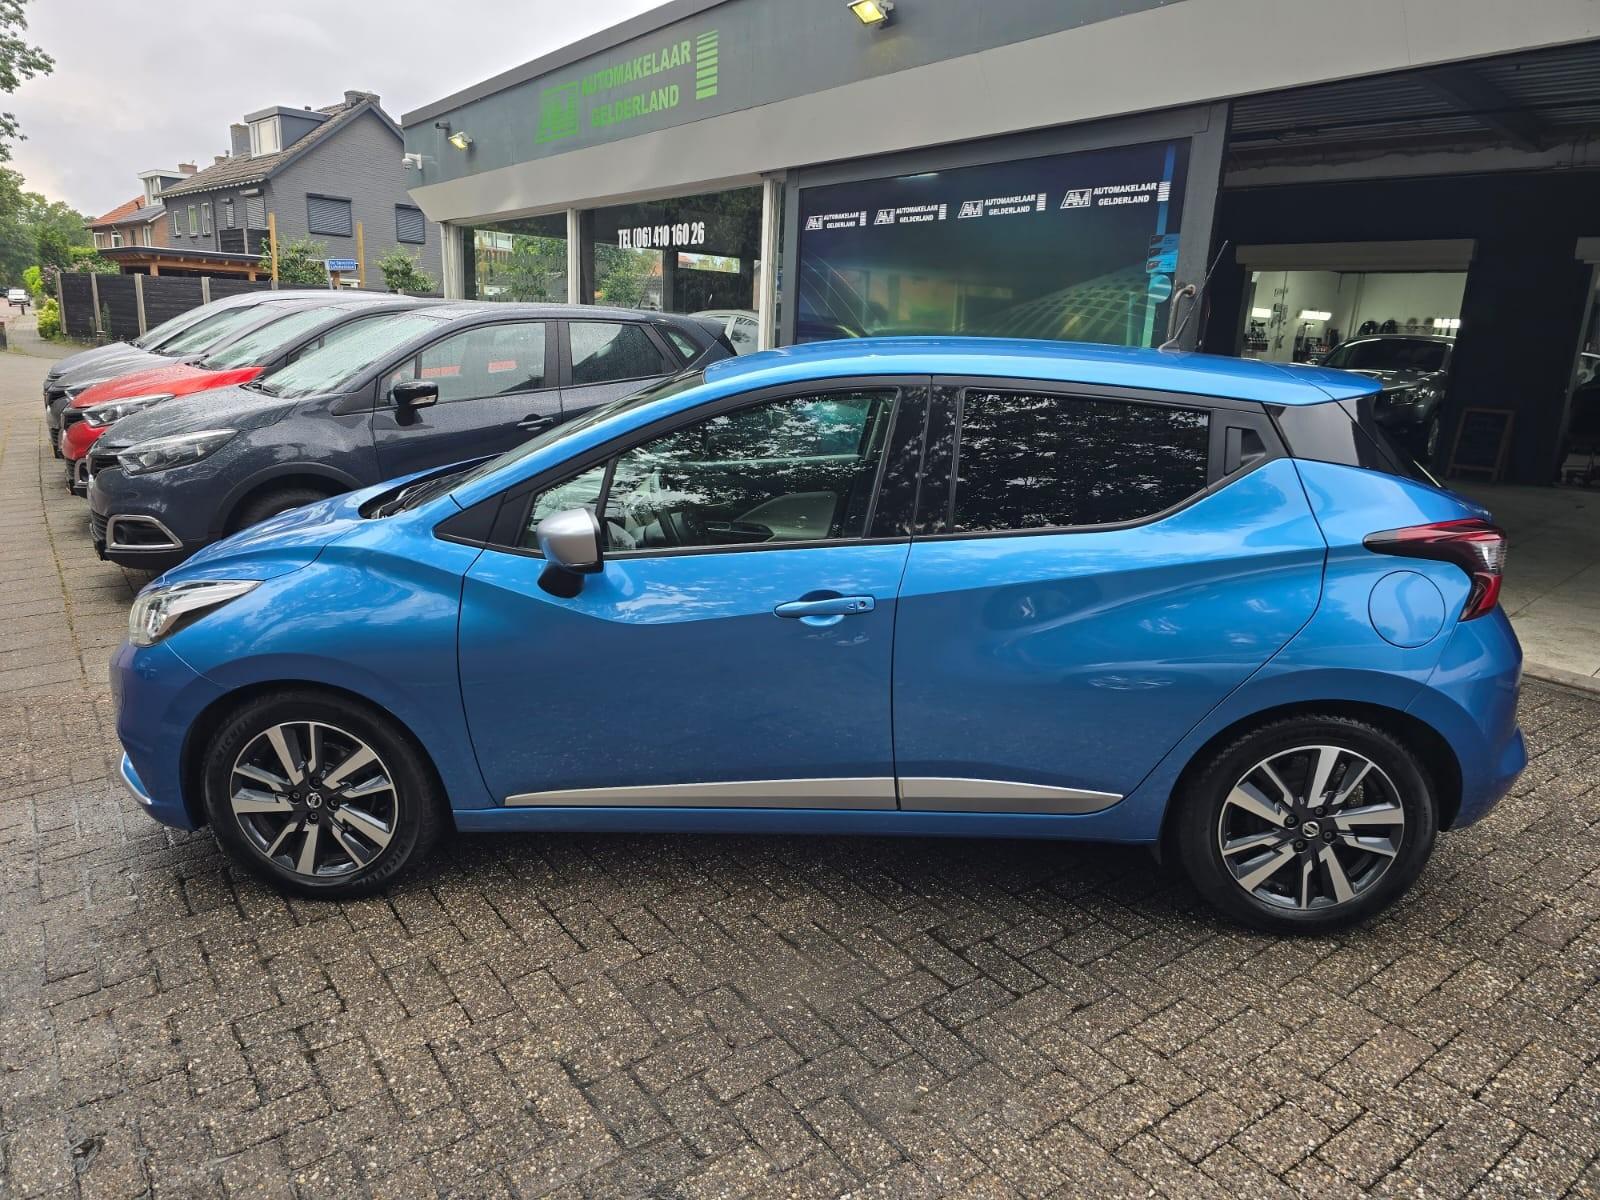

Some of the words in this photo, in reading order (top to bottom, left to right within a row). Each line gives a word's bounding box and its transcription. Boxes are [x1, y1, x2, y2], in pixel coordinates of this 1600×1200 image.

[581, 40, 691, 97] AUTOMAKELAAR
[591, 84, 679, 128] GELDERLAND
[1093, 182, 1157, 195] AUTOMAKELAAR
[984, 194, 1036, 206] AUTOMAKELAAR
[1098, 195, 1149, 205] GELDERLAND
[896, 205, 938, 215] AUTOMAKELAAR
[988, 206, 1030, 215] GELDERLAND
[899, 215, 934, 223] GELDERLAND
[618, 229, 632, 249] TEL
[633, 226, 652, 248] (06)
[653, 225, 669, 247] 410
[671, 223, 690, 246] 160
[690, 221, 705, 245] 26
